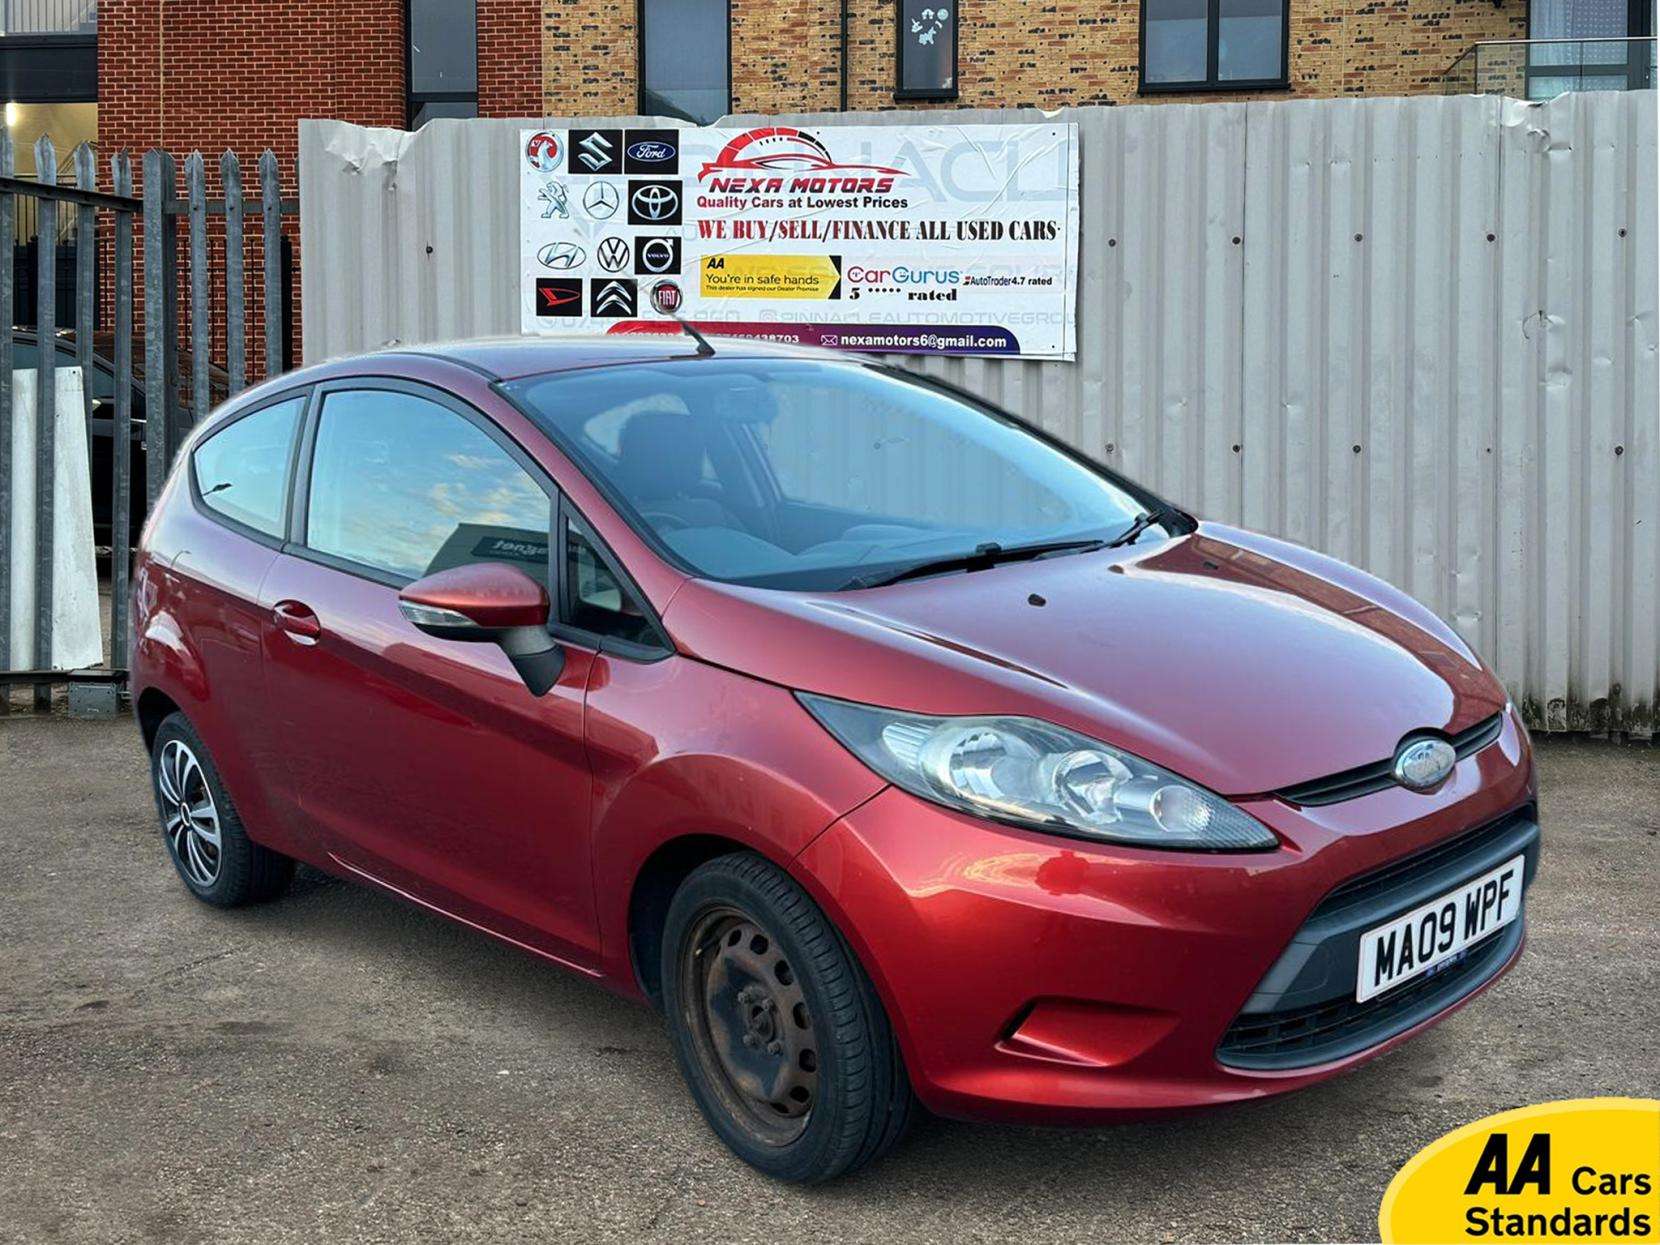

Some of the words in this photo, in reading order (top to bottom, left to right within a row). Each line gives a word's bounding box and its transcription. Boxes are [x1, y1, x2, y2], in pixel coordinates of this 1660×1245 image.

[636, 144, 666, 159] Ford
[709, 177, 784, 194] NEXA
[789, 177, 895, 194] MOTORS
[697, 196, 747, 210] Quality
[752, 196, 784, 208] Cars
[788, 197, 802, 208] at
[807, 196, 858, 209] Lowest
[863, 196, 909, 209] Prices
[697, 219, 727, 239] WE
[916, 220, 951, 241] ALL
[956, 220, 1004, 241] USED
[1008, 220, 1057, 241] CARS
[706, 257, 725, 269] AA
[705, 274, 741, 284] You're
[744, 274, 754, 284] in
[757, 274, 781, 284] safe
[784, 274, 820, 285] hands
[847, 266, 960, 284] CarGurus
[1028, 277, 1053, 285] rated
[657, 289, 677, 306] FIAT
[849, 287, 860, 300] 5
[907, 288, 958, 300] rated
[840, 334, 1007, 349] nexamotors6@gmail.com
[1374, 902, 1457, 987] MA09
[1463, 868, 1514, 940] WPF
